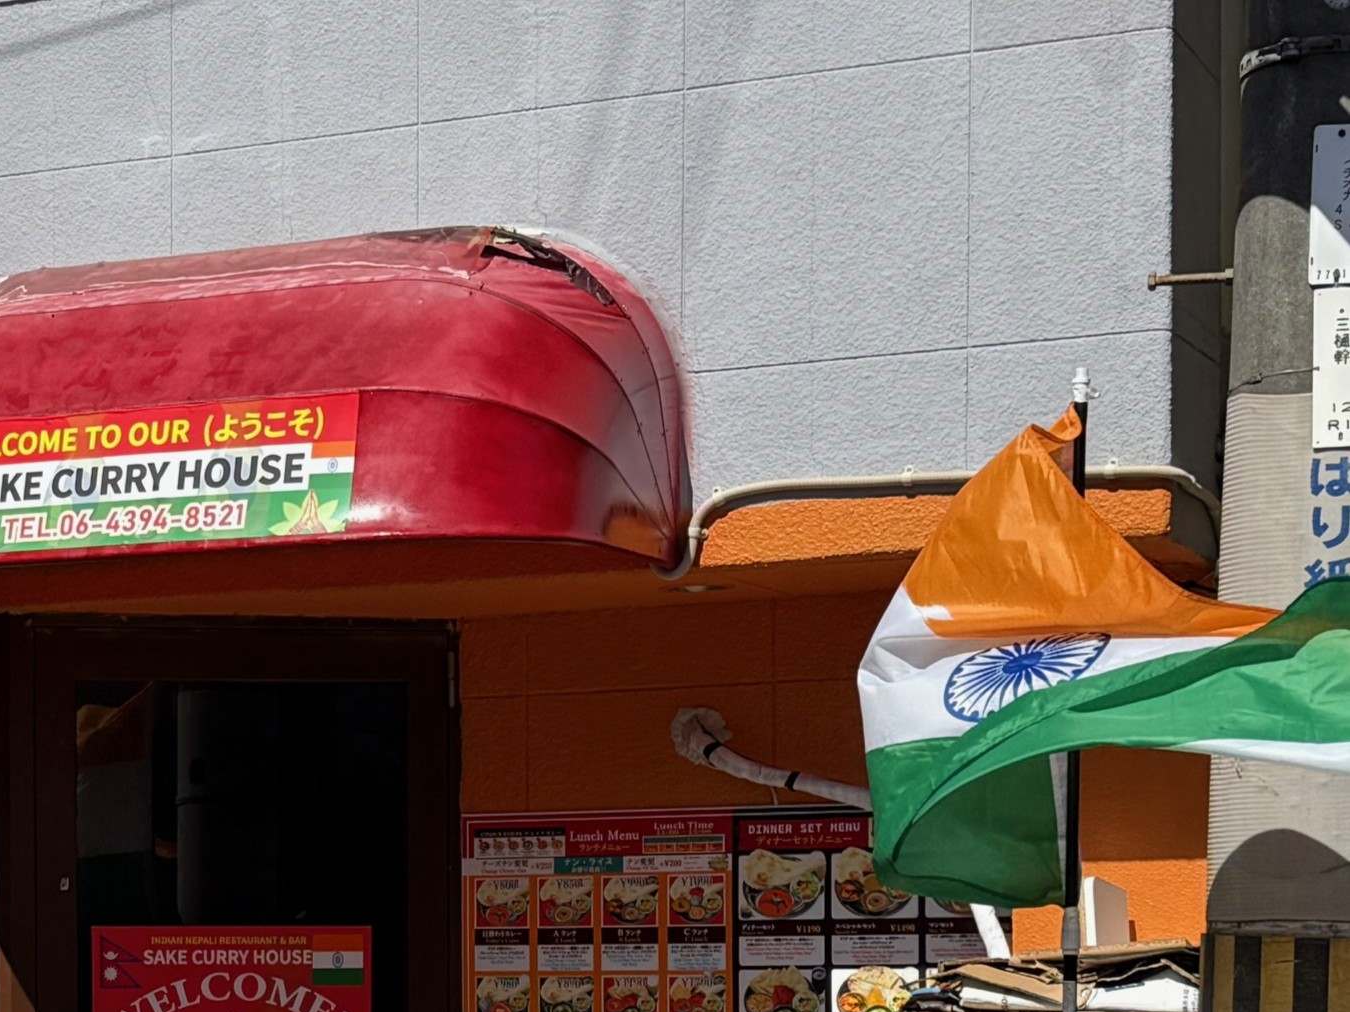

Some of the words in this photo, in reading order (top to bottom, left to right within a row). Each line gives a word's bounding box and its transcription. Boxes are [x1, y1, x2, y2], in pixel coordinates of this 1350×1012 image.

[85, 425, 122, 450] TO
[129, 418, 190, 447] OUR
[204, 406, 325, 448] (ようこそ)
[52, 461, 169, 499] CURRY
[177, 453, 305, 490] HOUSE
[748, 823, 793, 834] DINNER
[800, 823, 823, 834] SET
[830, 822, 861, 833] MENU
[569, 830, 603, 842] Lunch
[607, 829, 640, 841] Menu
[151, 936, 183, 945] INDIAN
[185, 936, 217, 945] NEPALI
[143, 950, 187, 965] SAKE
[192, 950, 248, 965] CURRY
[253, 949, 312, 965] HOUSE
